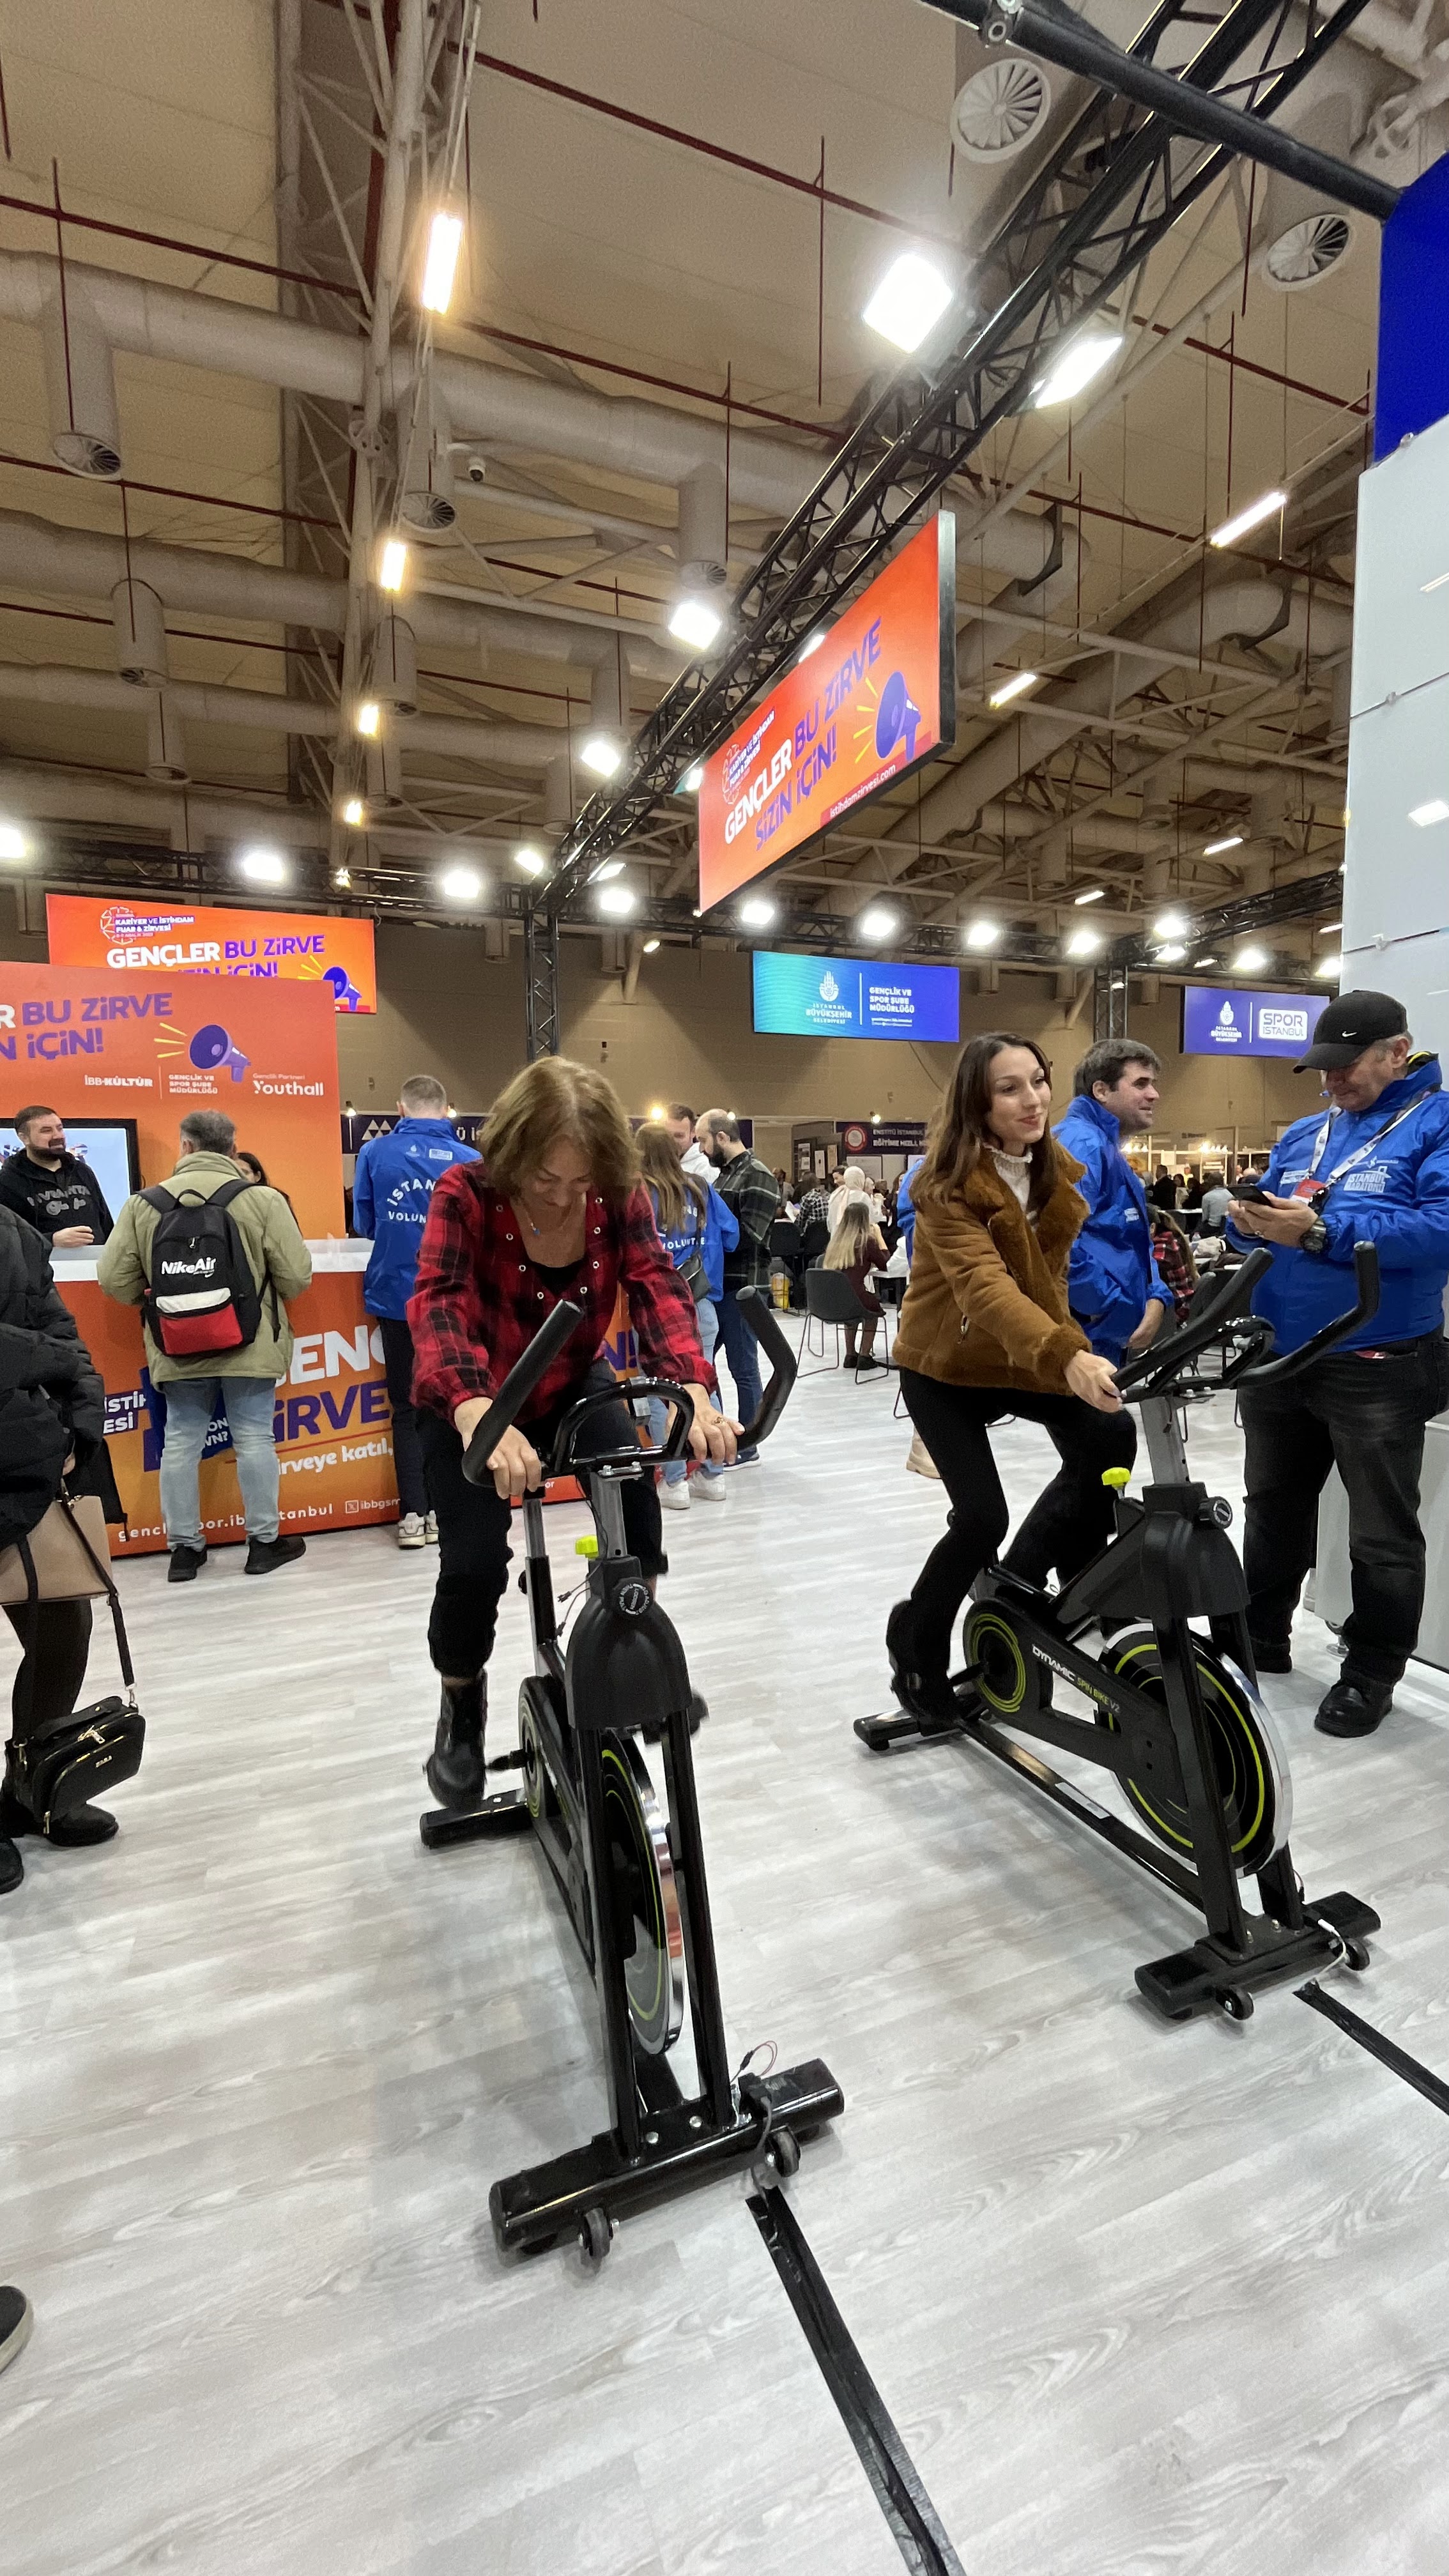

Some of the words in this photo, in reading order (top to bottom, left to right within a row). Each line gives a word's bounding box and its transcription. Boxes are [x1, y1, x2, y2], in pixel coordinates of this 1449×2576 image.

[725, 738, 792, 845] GENÇLER
[795, 698, 819, 760] BU
[115, 917, 148, 925] KARİYER
[107, 941, 220, 969] GENÇLER
[224, 939, 257, 959] BU
[869, 986, 901, 996] GENÇLİK
[869, 995, 890, 1004] SPOR
[22, 999, 71, 1026] BU
[1262, 1013, 1303, 1027] SPOR
[253, 1080, 324, 1096] Youthall
[388, 1211, 427, 1224] VOLUN
[1032, 1643, 1077, 1682] DYNAMIC
